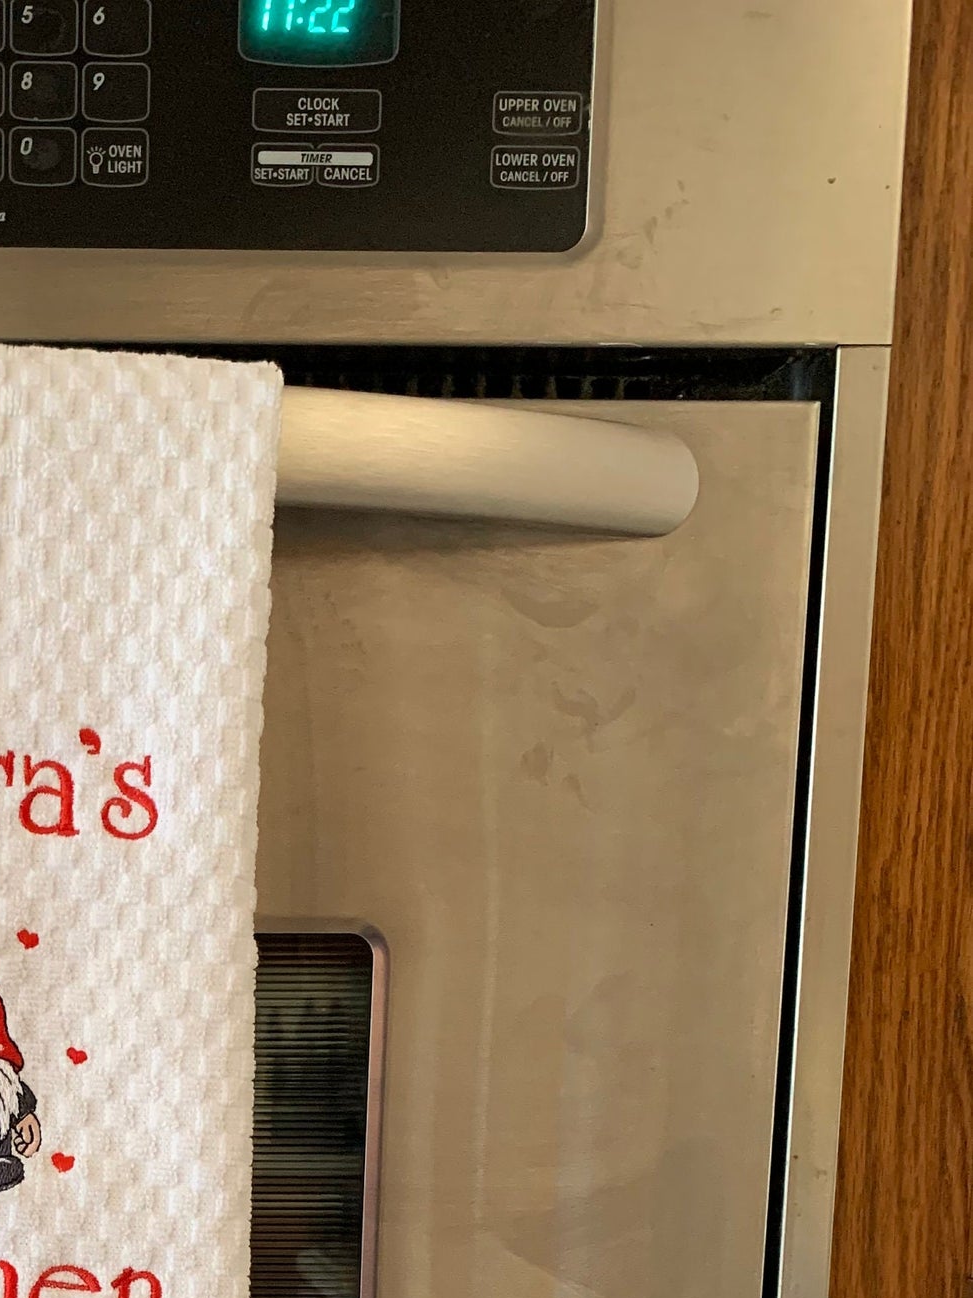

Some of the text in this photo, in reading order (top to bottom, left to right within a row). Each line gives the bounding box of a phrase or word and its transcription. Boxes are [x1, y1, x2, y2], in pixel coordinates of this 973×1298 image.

[21, 5, 33, 24] 5
[93, 6, 106, 25] 6
[262, 0, 355, 33] 11:22
[20, 71, 33, 90] 8
[92, 72, 105, 91] 9
[297, 97, 340, 111] CLOCK
[499, 98, 577, 112] UPPER OVEN
[108, 144, 142, 158] OVEN
[300, 153, 333, 163] TIMER
[107, 160, 143, 174] LIGHT
[495, 153, 576, 167] LOWER OVEN
[323, 167, 373, 181] CANCEL
